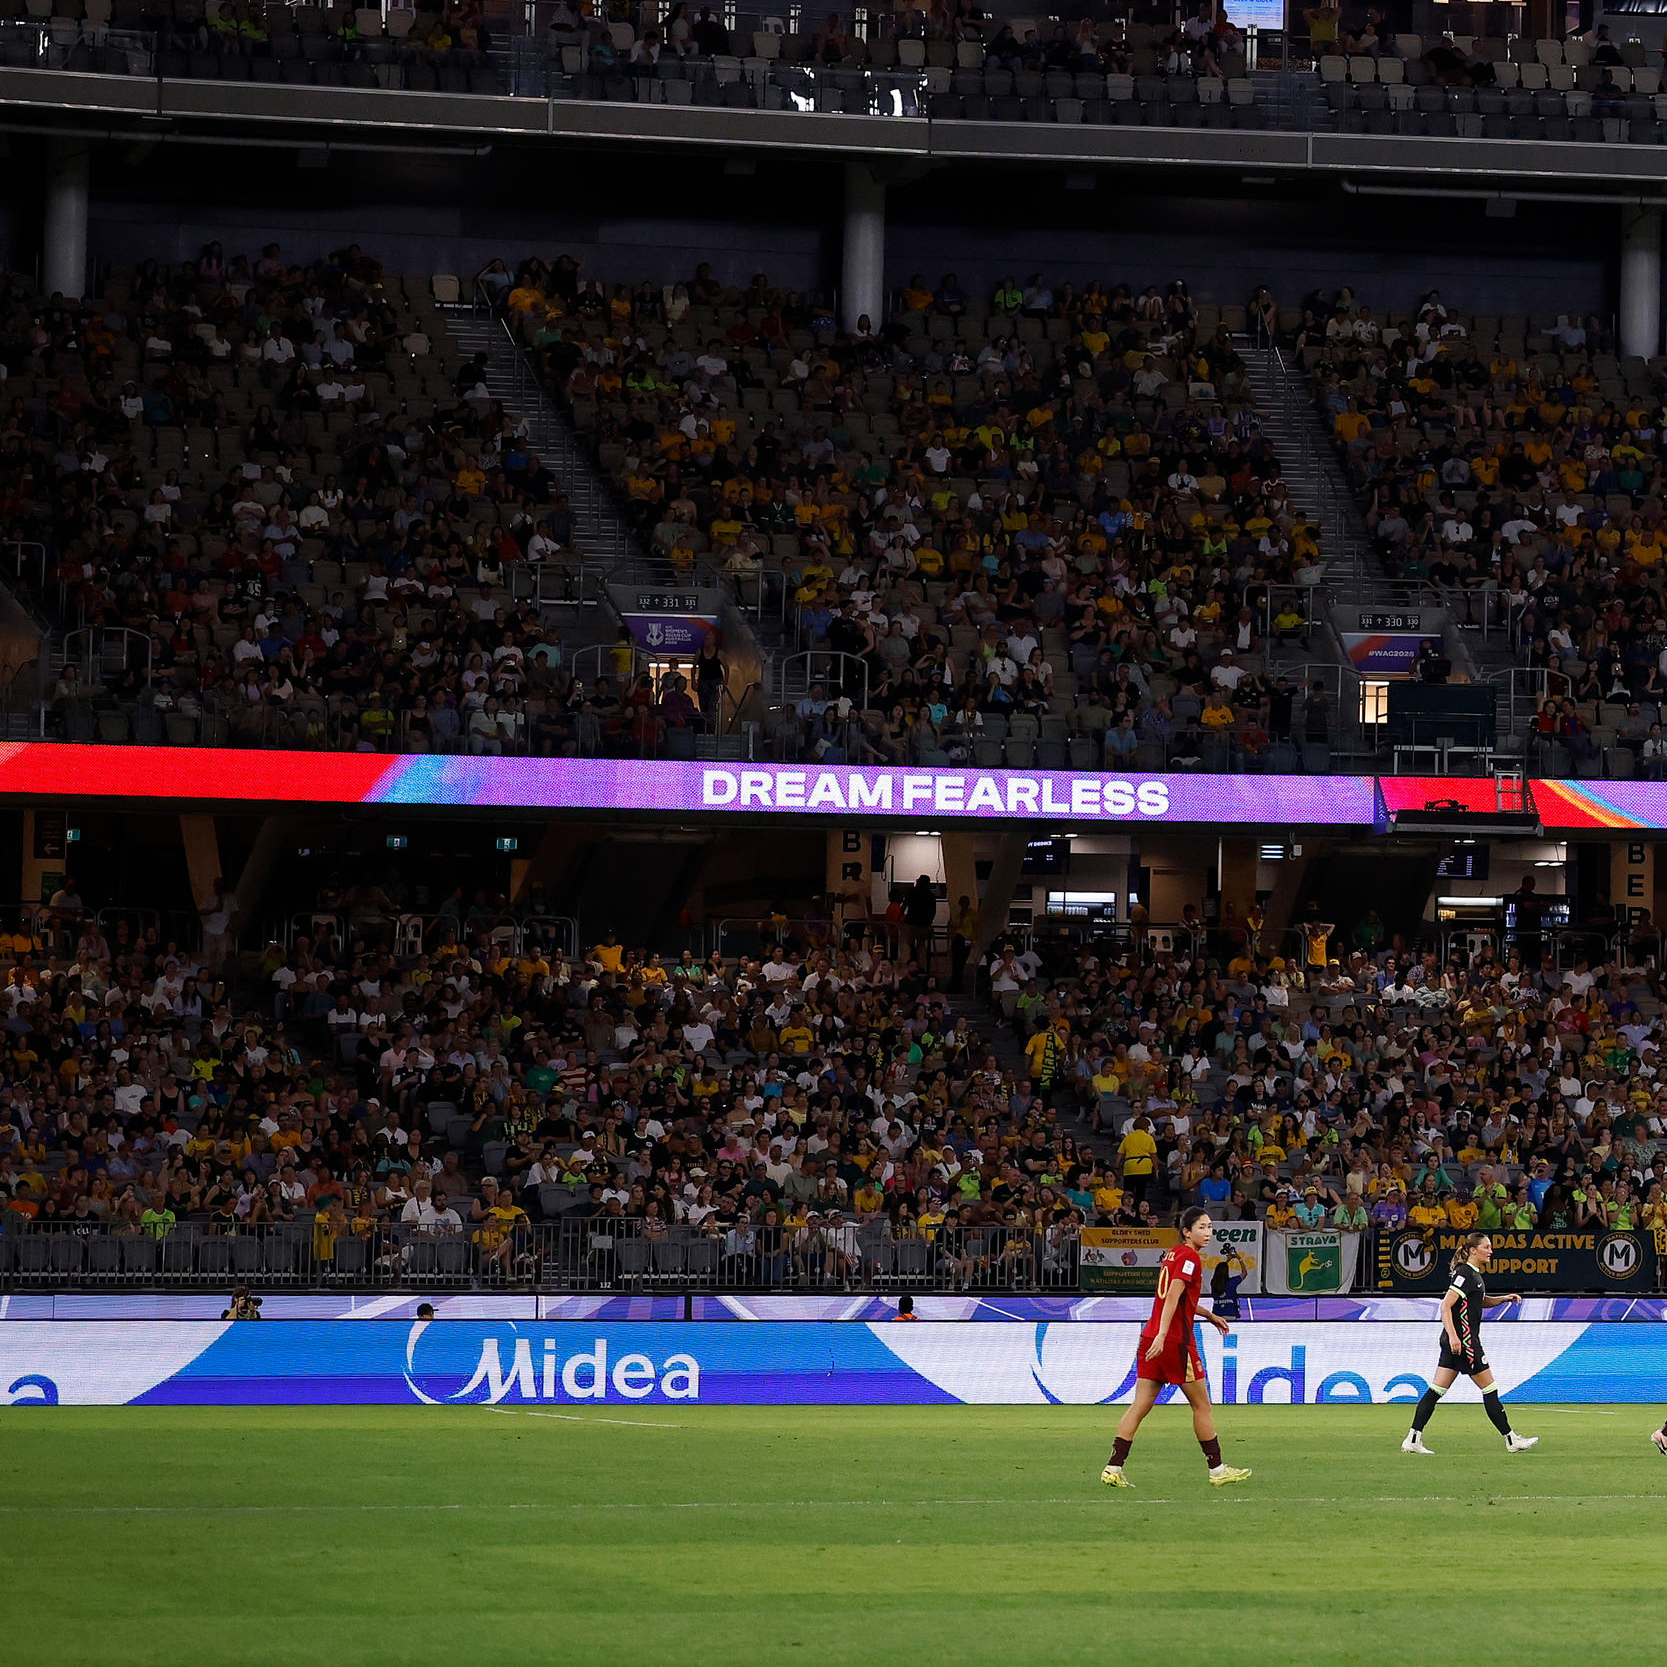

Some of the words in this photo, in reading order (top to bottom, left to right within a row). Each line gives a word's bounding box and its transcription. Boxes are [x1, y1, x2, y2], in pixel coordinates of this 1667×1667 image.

[662, 598, 679, 608] 331
[1384, 617, 1402, 627] 330
[702, 771, 893, 809] DREAM
[902, 776, 1170, 815] FEARLESS
[1440, 1234, 1527, 1250] MADAS
[1531, 1234, 1595, 1250] ACTIVE
[1403, 1243, 1424, 1266] M
[1608, 1243, 1631, 1266] M
[600, 1281, 611, 1289] 132
[447, 1338, 700, 1402] Midea
